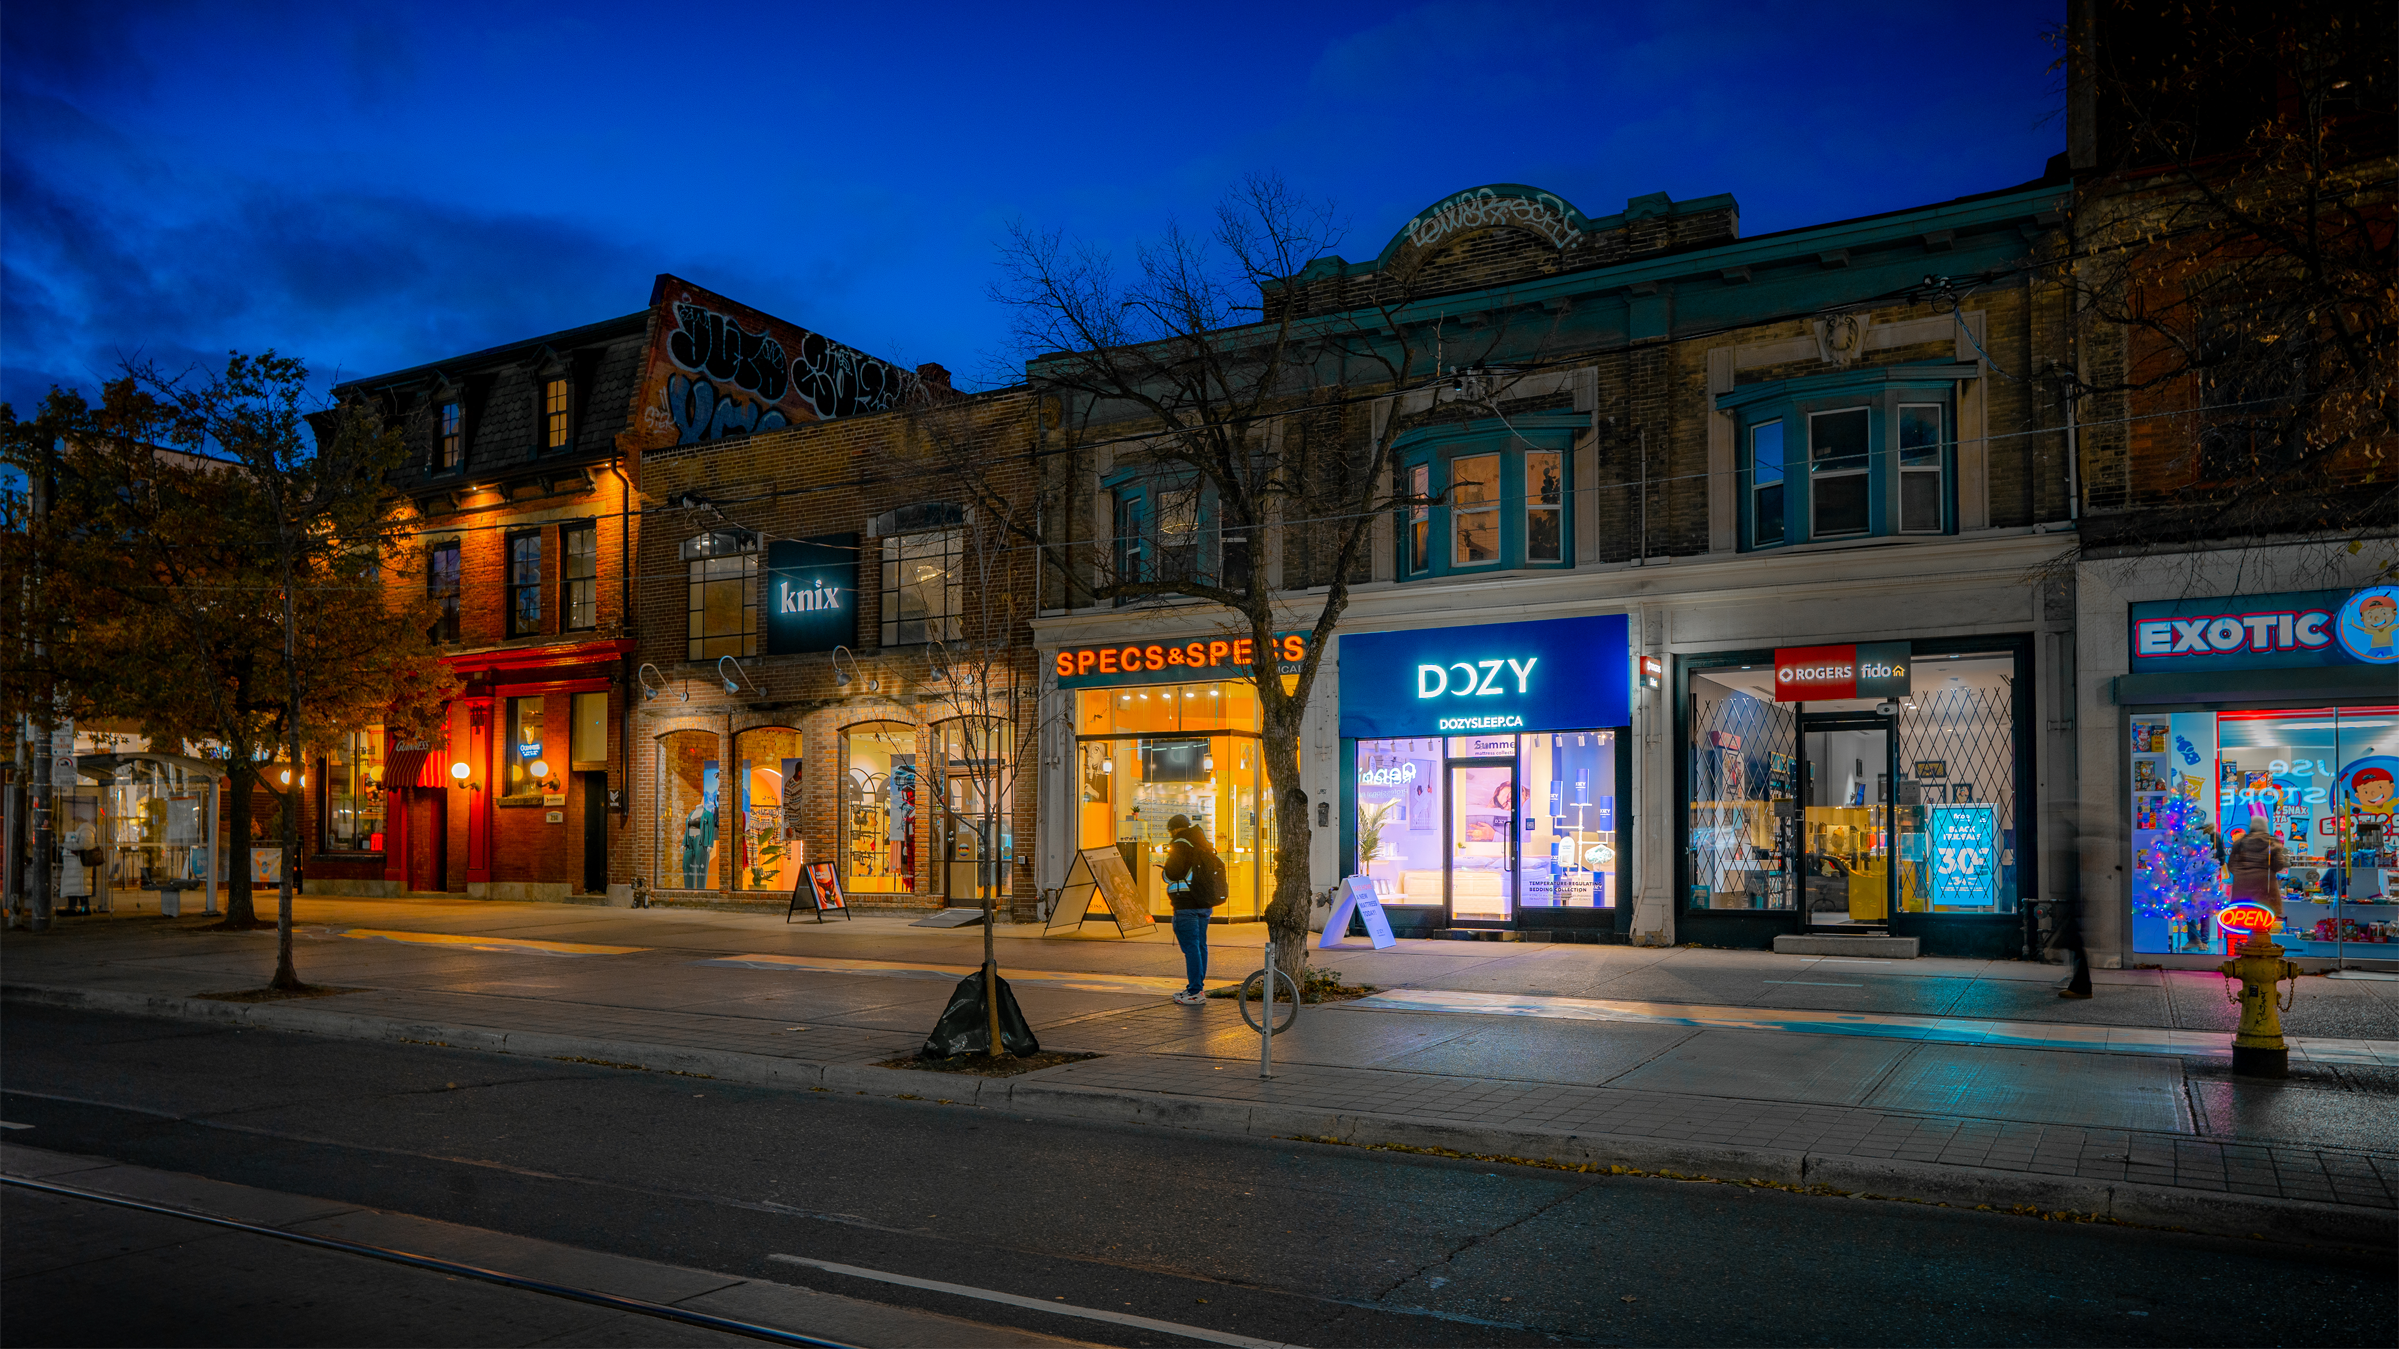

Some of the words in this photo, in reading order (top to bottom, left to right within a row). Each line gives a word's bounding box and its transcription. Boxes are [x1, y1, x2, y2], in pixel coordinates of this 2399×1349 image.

[780, 579, 839, 613] knix
[2138, 610, 2333, 655] EXOTIC
[1056, 635, 1305, 677] SPECS&SPES
[1418, 657, 1538, 699] DOZY
[1796, 666, 1852, 680] ROGERS
[1861, 663, 1892, 679] fido
[1440, 715, 1524, 730] DOZYSLEEP.CA
[2283, 805, 2308, 815] SNAX
[1362, 883, 1373, 891] HOME
[2221, 910, 2270, 926] OPEN
